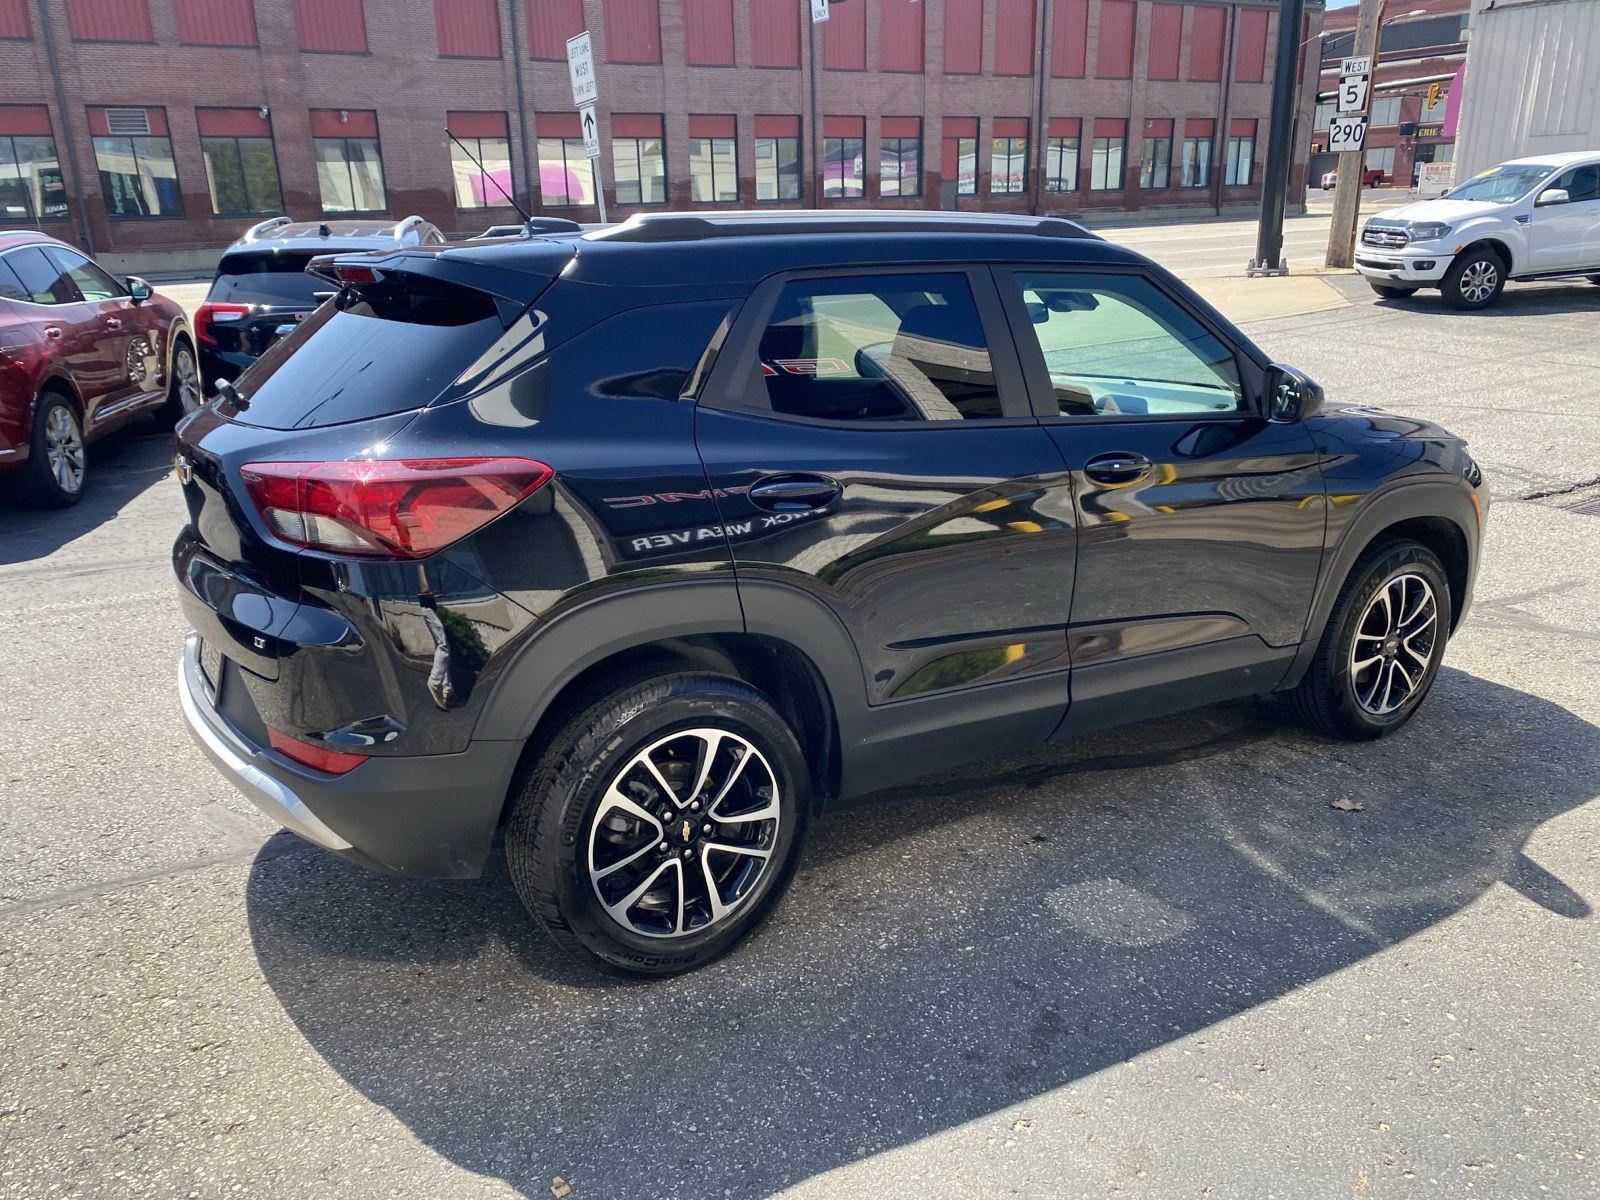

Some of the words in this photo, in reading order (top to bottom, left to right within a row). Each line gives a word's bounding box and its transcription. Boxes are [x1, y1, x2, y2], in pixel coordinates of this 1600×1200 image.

[814, 9, 826, 19] ONLY
[570, 45, 579, 59] LEFT
[575, 61, 588, 77] MUST
[1345, 61, 1368, 73] WEST
[1346, 85, 1358, 104] 5
[1331, 124, 1363, 143] 290
